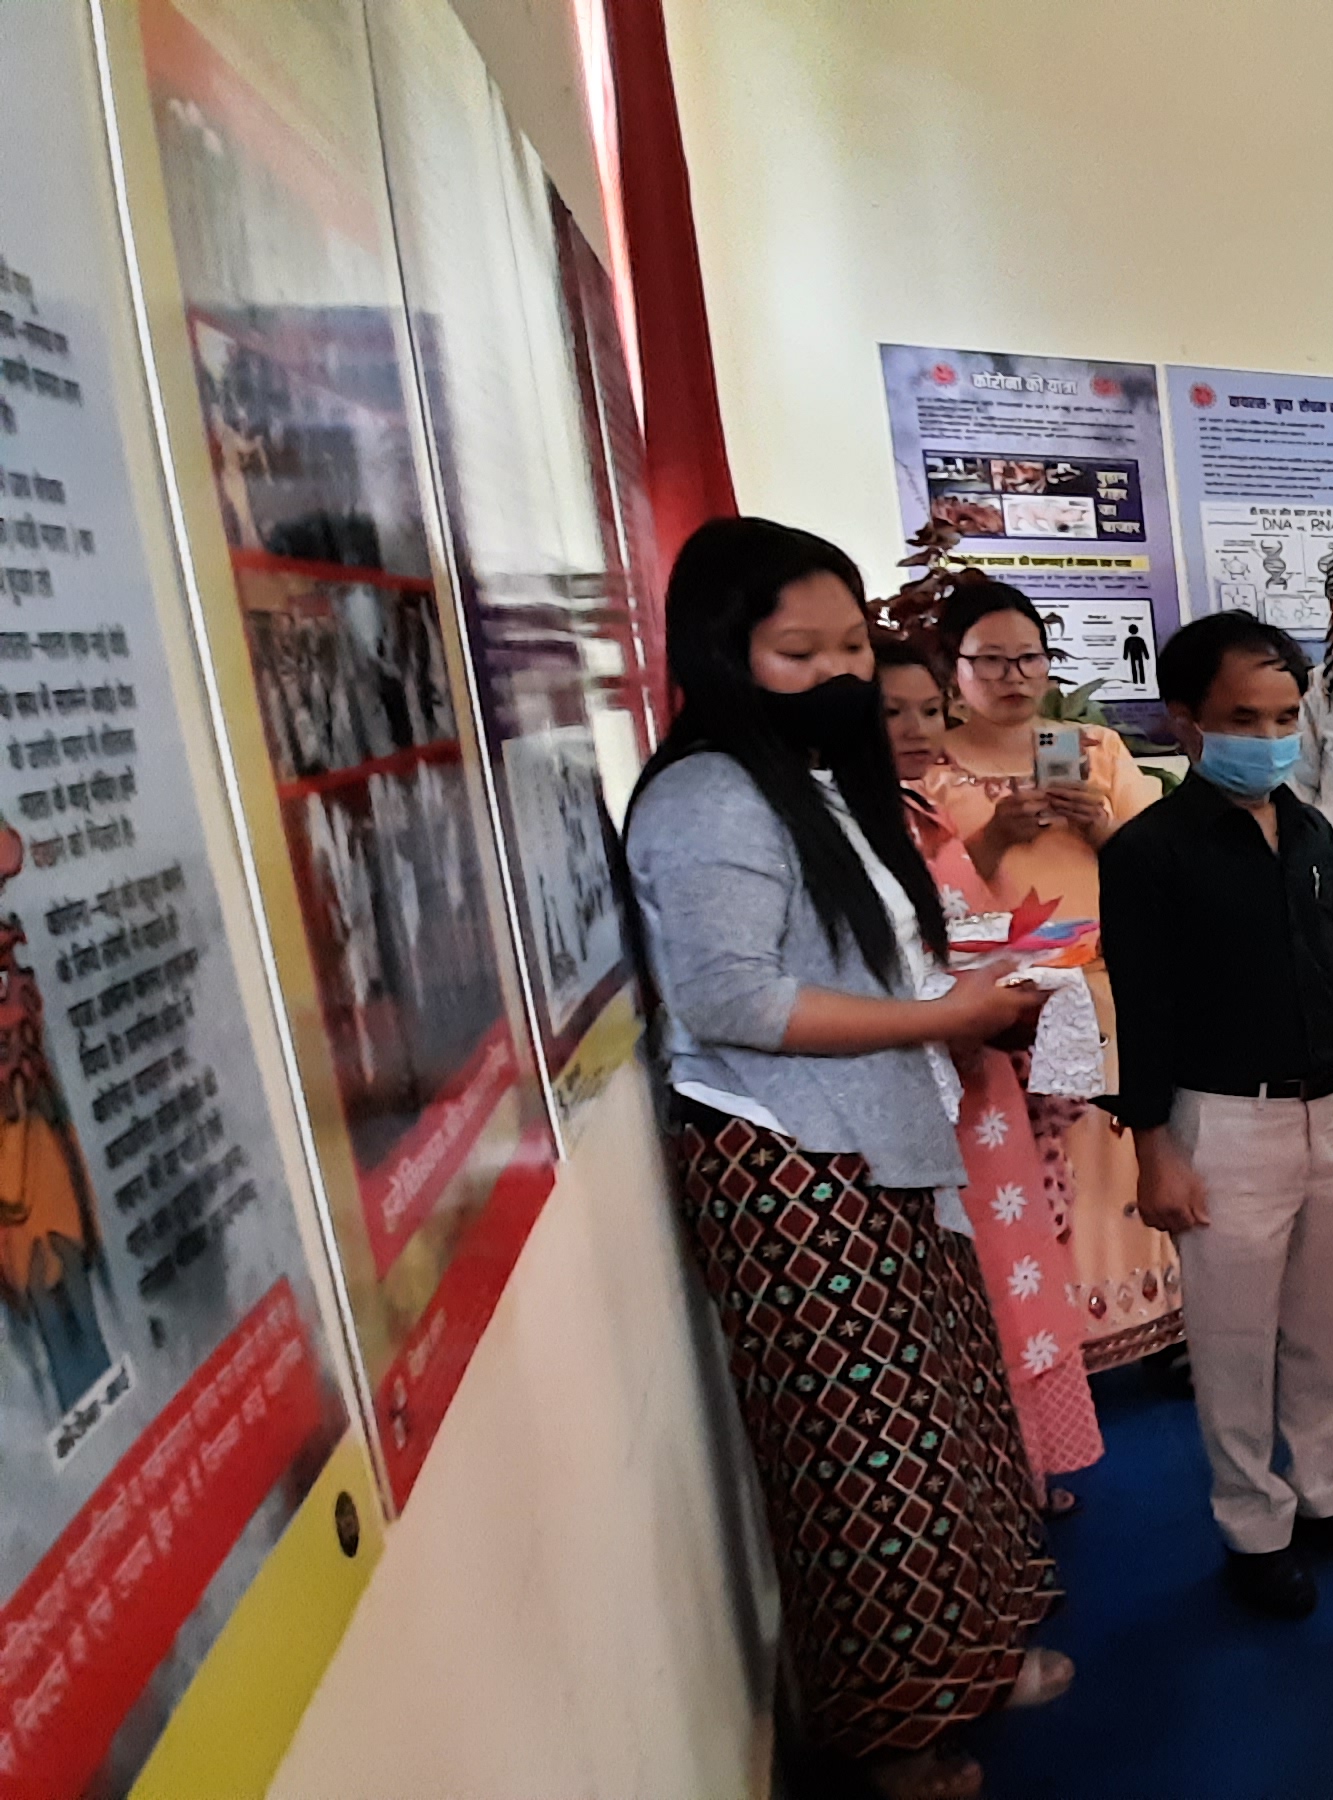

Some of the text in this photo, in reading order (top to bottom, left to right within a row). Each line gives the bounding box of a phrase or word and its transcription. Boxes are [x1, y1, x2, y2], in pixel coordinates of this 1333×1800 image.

[971, 371, 1077, 395] कोरोना की यात्रा
[1262, 517, 1292, 531] DNA
